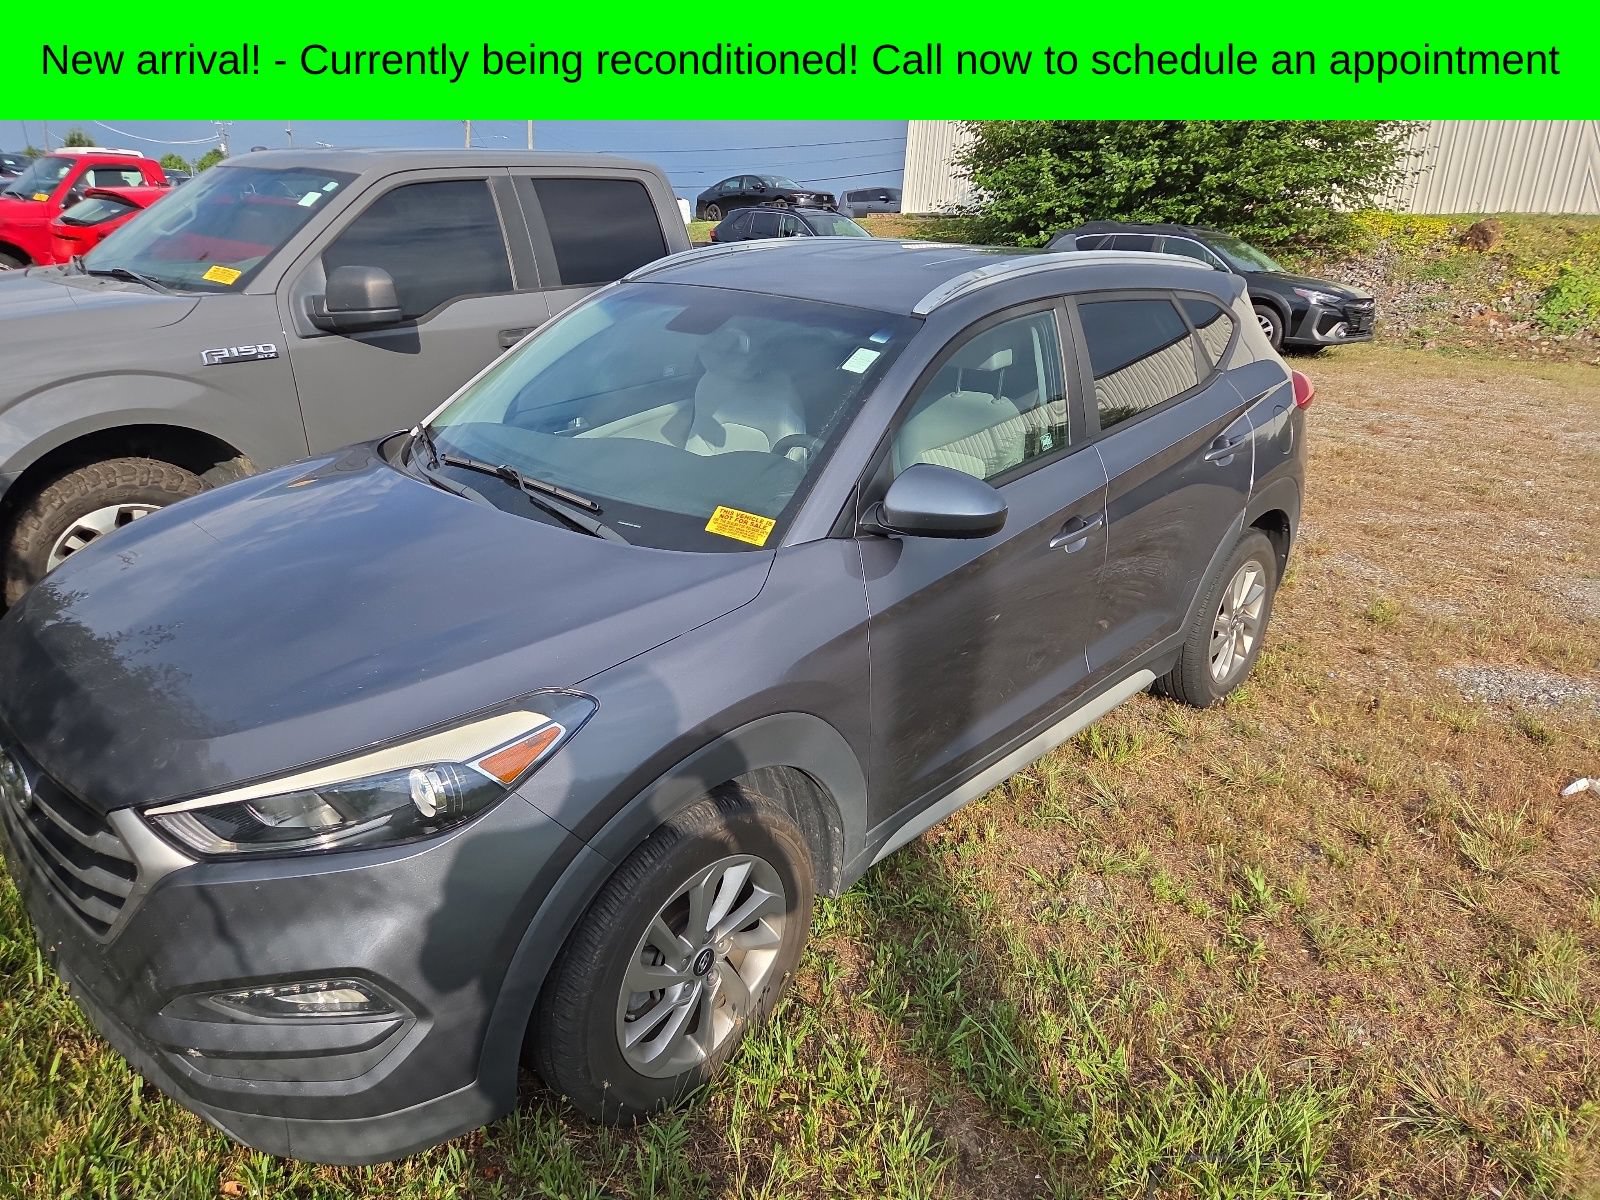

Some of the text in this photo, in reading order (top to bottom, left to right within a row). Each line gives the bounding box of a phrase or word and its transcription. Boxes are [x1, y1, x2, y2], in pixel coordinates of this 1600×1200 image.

[720, 508, 734, 516] THIS
[735, 512, 764, 525] VEHICLE
[734, 517, 749, 525] FOR
[750, 521, 769, 531] SALE
